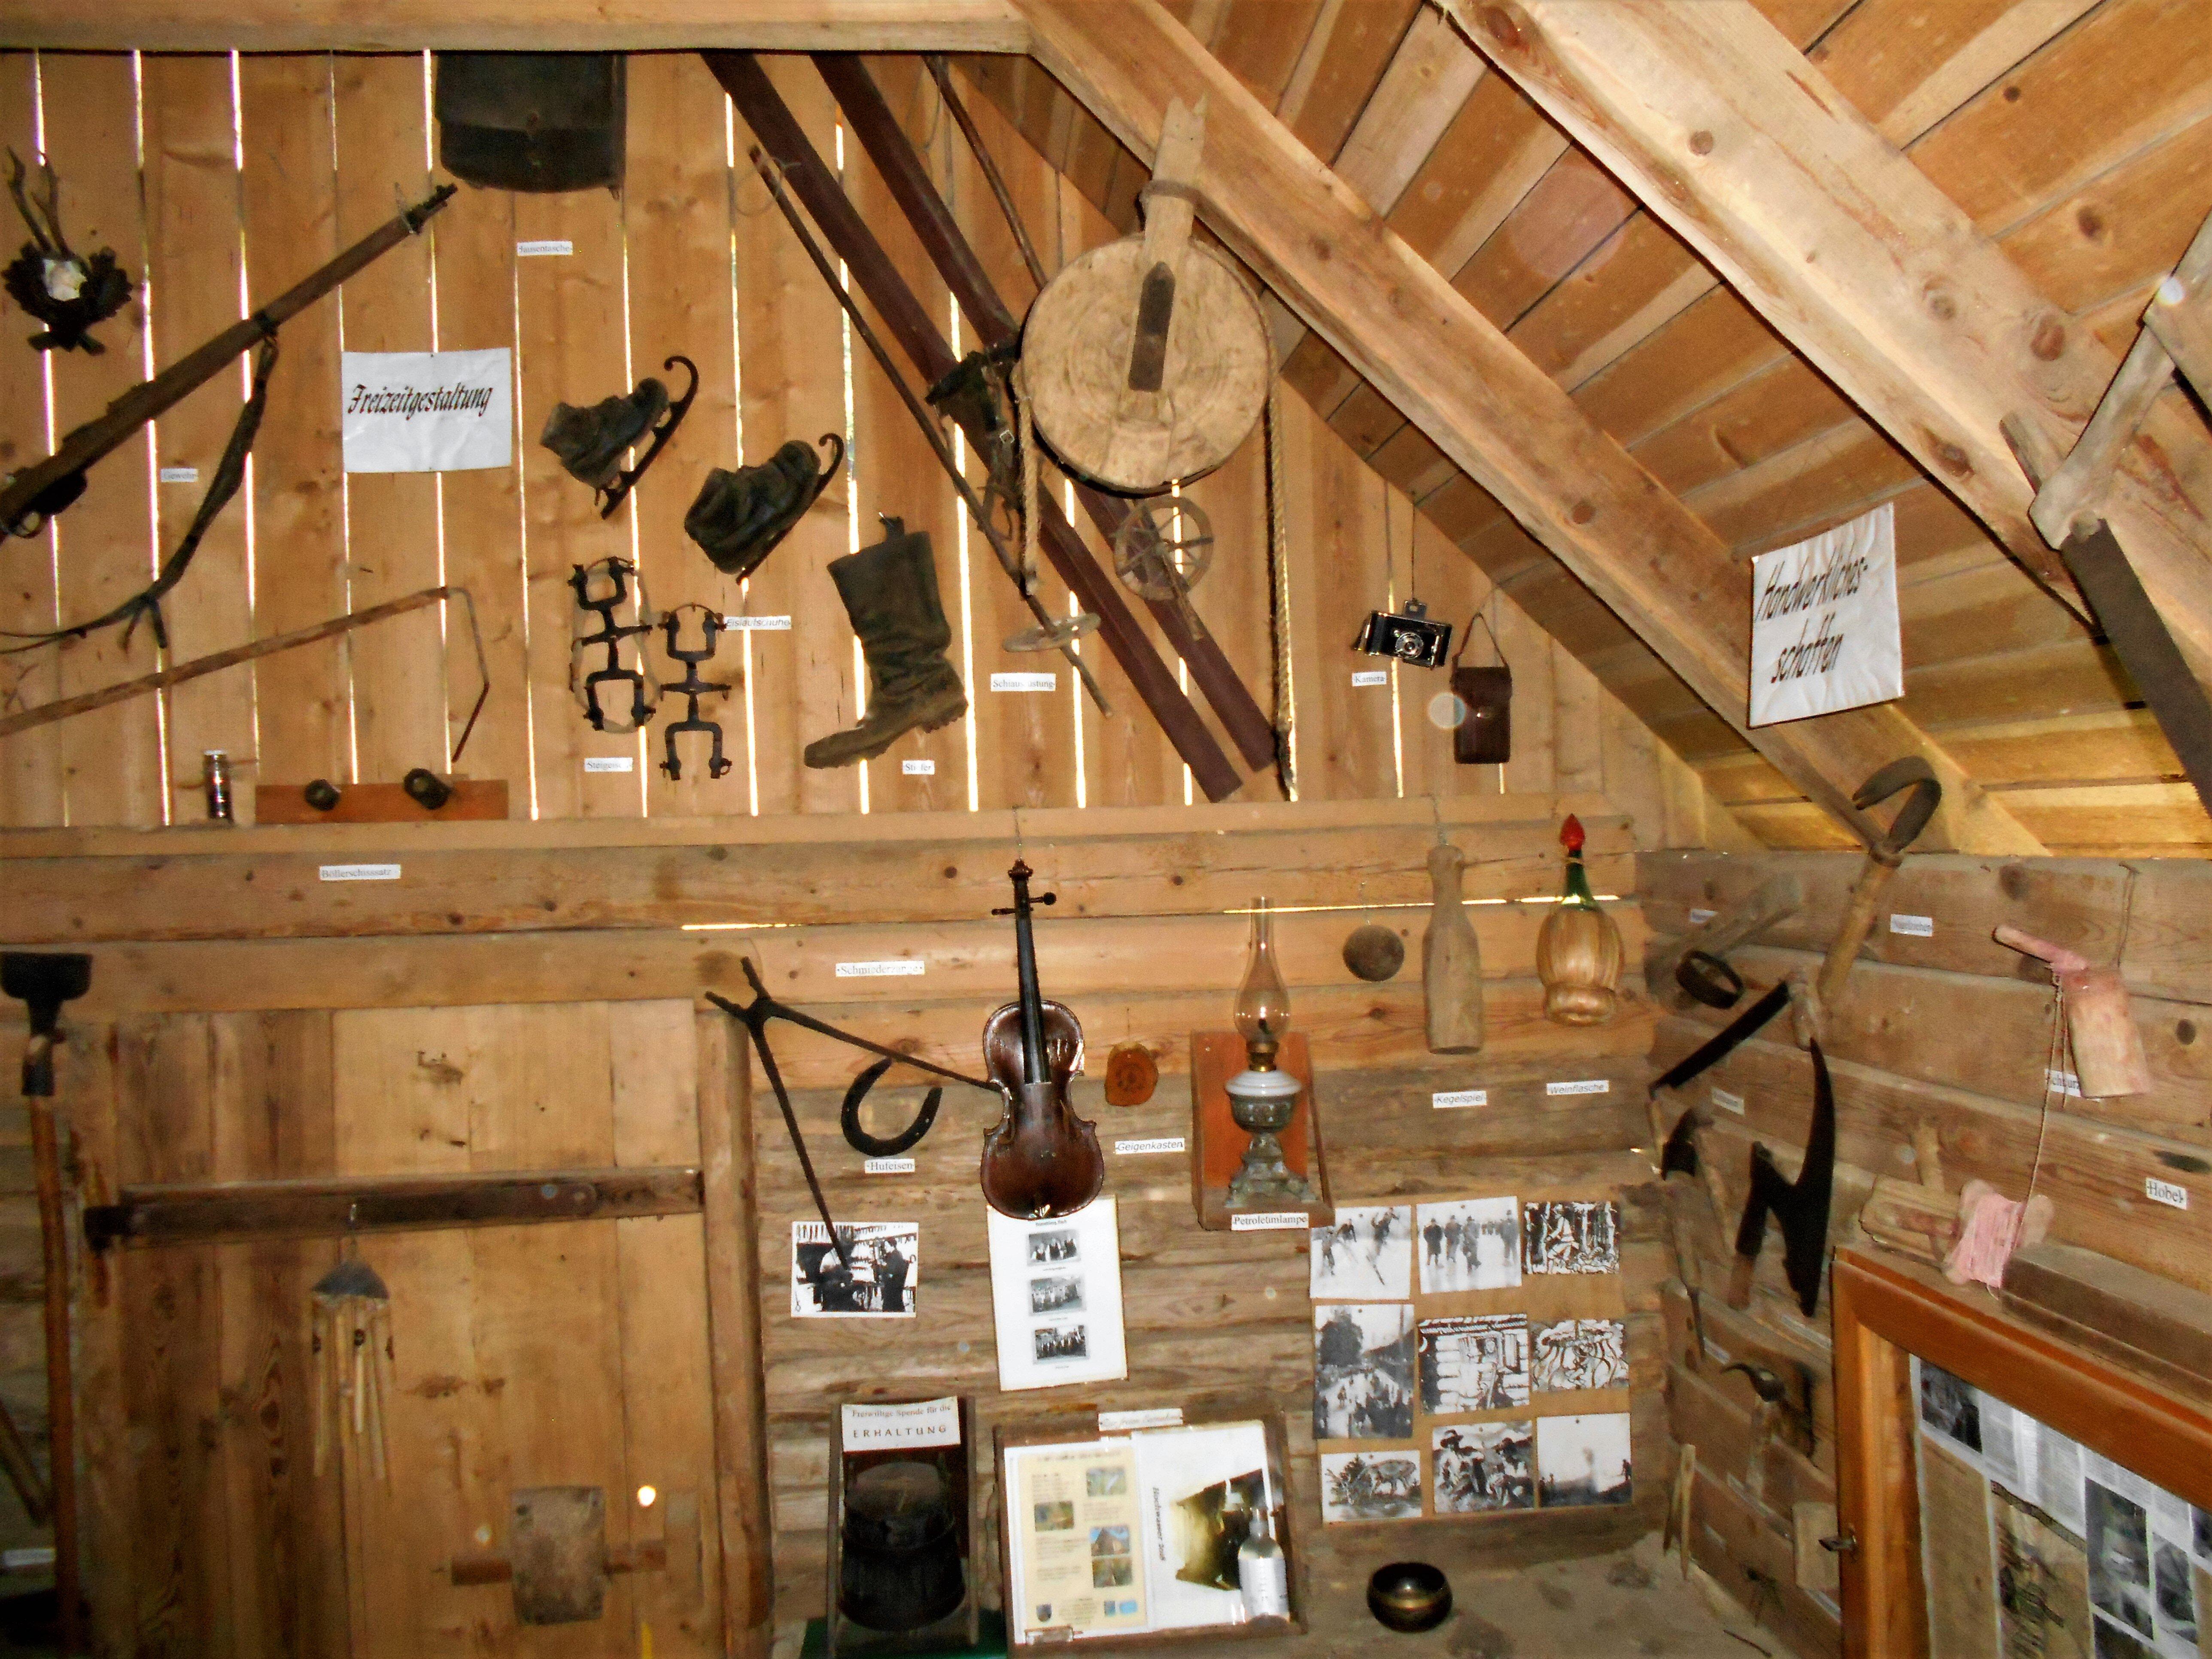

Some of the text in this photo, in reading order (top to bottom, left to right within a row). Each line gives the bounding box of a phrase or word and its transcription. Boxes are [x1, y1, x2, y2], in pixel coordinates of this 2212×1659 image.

[347, 382, 493, 420] Freizeitgestaltung
[1771, 612, 1844, 683] schaffen
[993, 678, 1054, 688] Schiausstung
[587, 761, 629, 769] Steigeise
[905, 763, 931, 771] Stife
[841, 964, 918, 975] Schmiederzne
[1550, 1083, 1604, 1094] Weinflasche
[1436, 1093, 1483, 1104] Kegelspiel
[1118, 1140, 1183, 1152] Geigenkasten
[871, 1161, 912, 1170] Hufeisen
[2148, 1179, 2182, 1202] Hobel
[1234, 1214, 1306, 1224] Petroleumlampe
[853, 1424, 946, 1438] ERHALTUNG
